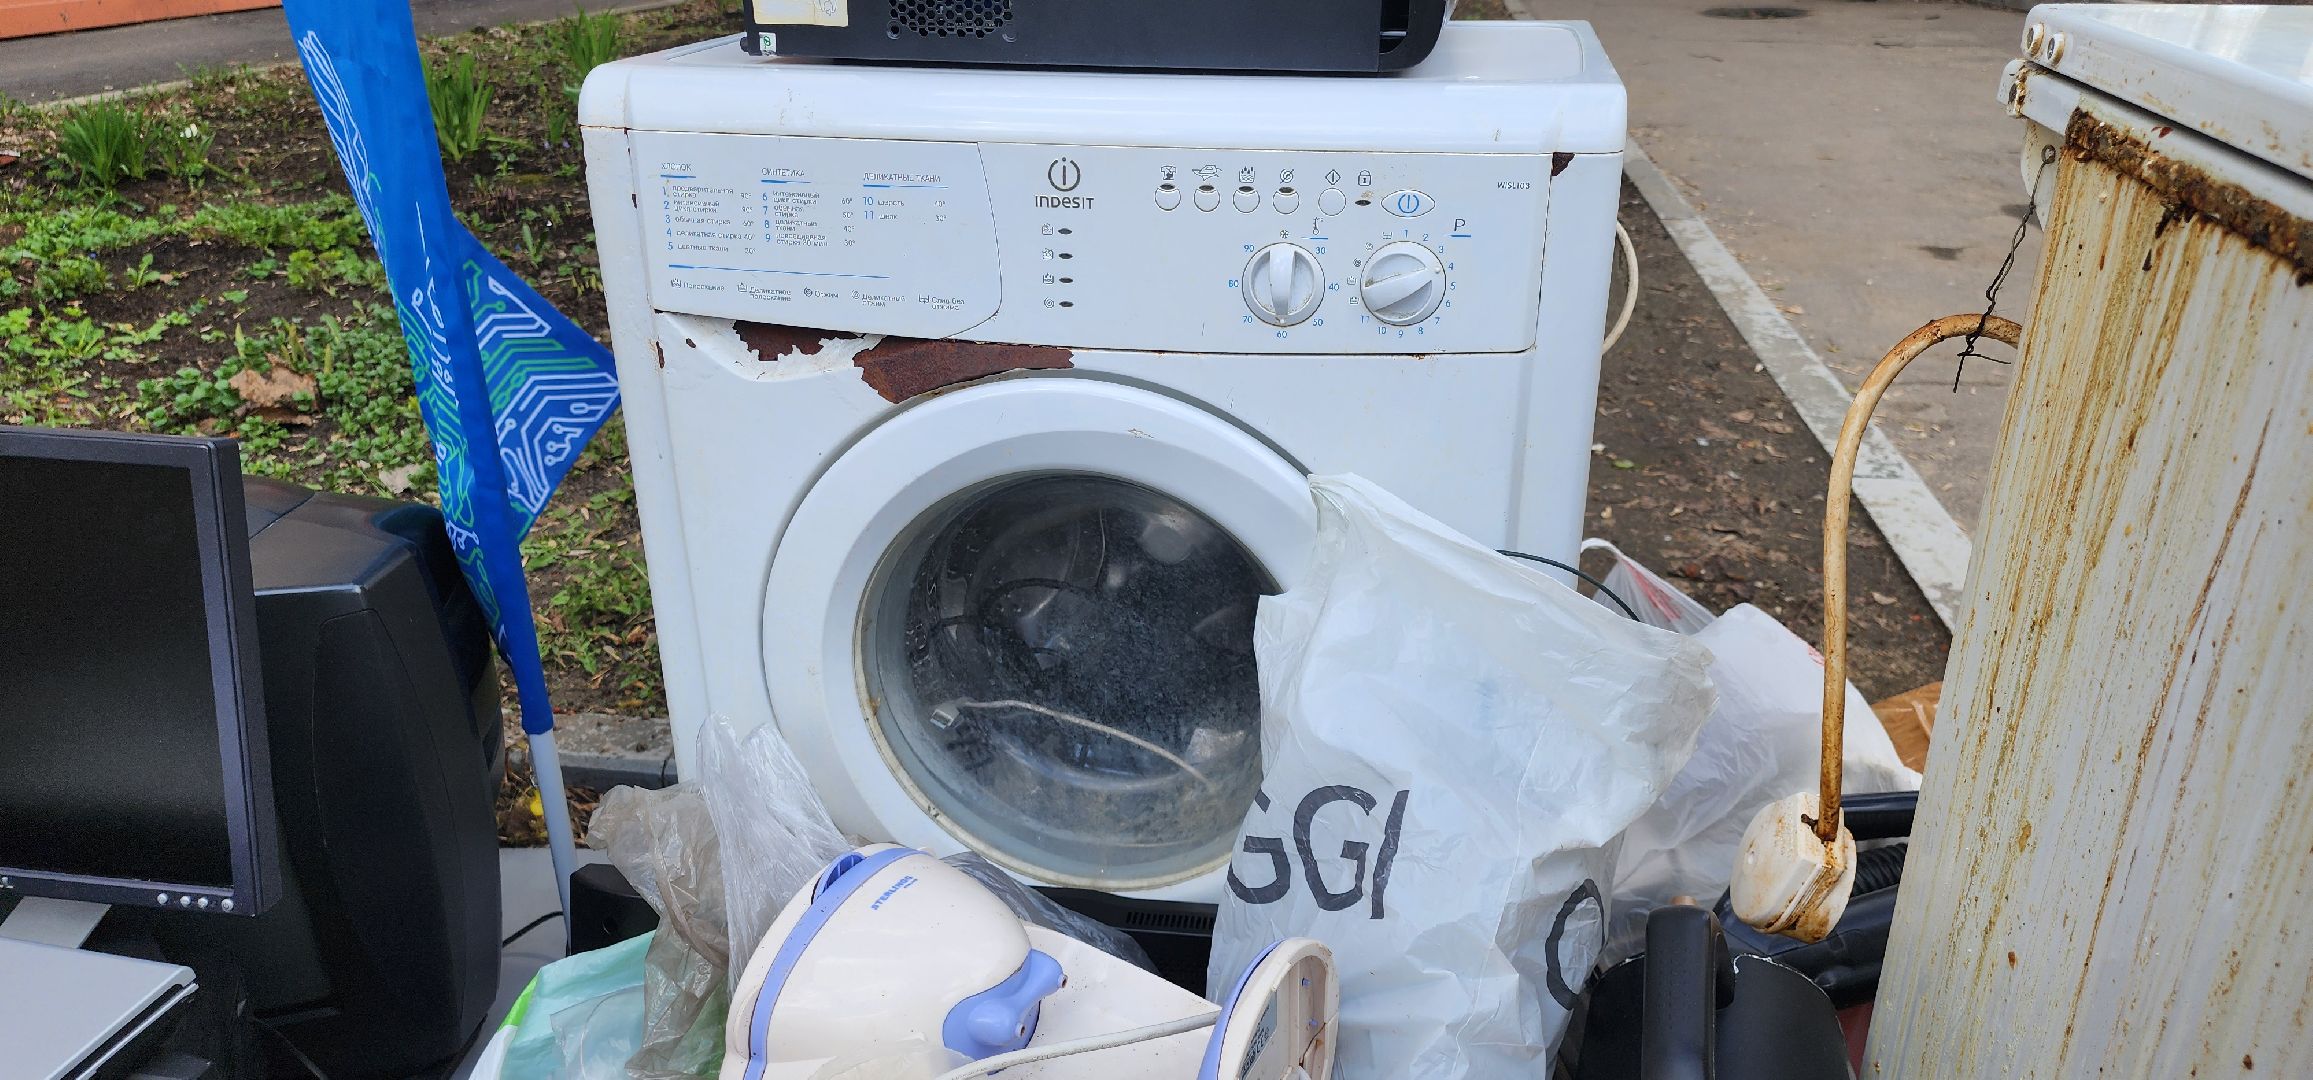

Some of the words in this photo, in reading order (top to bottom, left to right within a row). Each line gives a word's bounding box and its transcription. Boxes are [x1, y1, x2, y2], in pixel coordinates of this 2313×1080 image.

[916, 174, 941, 182] ТКАНИ
[762, 192, 768, 201] 6
[862, 196, 874, 206] 10
[664, 200, 670, 210] 2
[762, 205, 768, 215] 7
[665, 214, 671, 224] 3
[864, 210, 874, 220] 11
[764, 219, 770, 229] 8
[1453, 218, 1466, 231] P
[666, 227, 672, 238] 4
[1422, 233, 1429, 241] 2
[765, 233, 771, 242] 9
[667, 241, 673, 251] 5
[1243, 244, 1255, 252] 90
[1315, 246, 1326, 255] 30
[1438, 245, 1444, 253] 3
[1448, 262, 1454, 270] 4
[1328, 283, 1340, 291] 40
[1449, 281, 1456, 290] 5
[1445, 300, 1451, 308] 6
[1242, 316, 1253, 324] 70
[1434, 316, 1440, 325] 7
[1276, 330, 1288, 339] 60
[1377, 326, 1387, 335] 10
[1398, 329, 1404, 338] 9
[1418, 326, 1424, 335] 8
